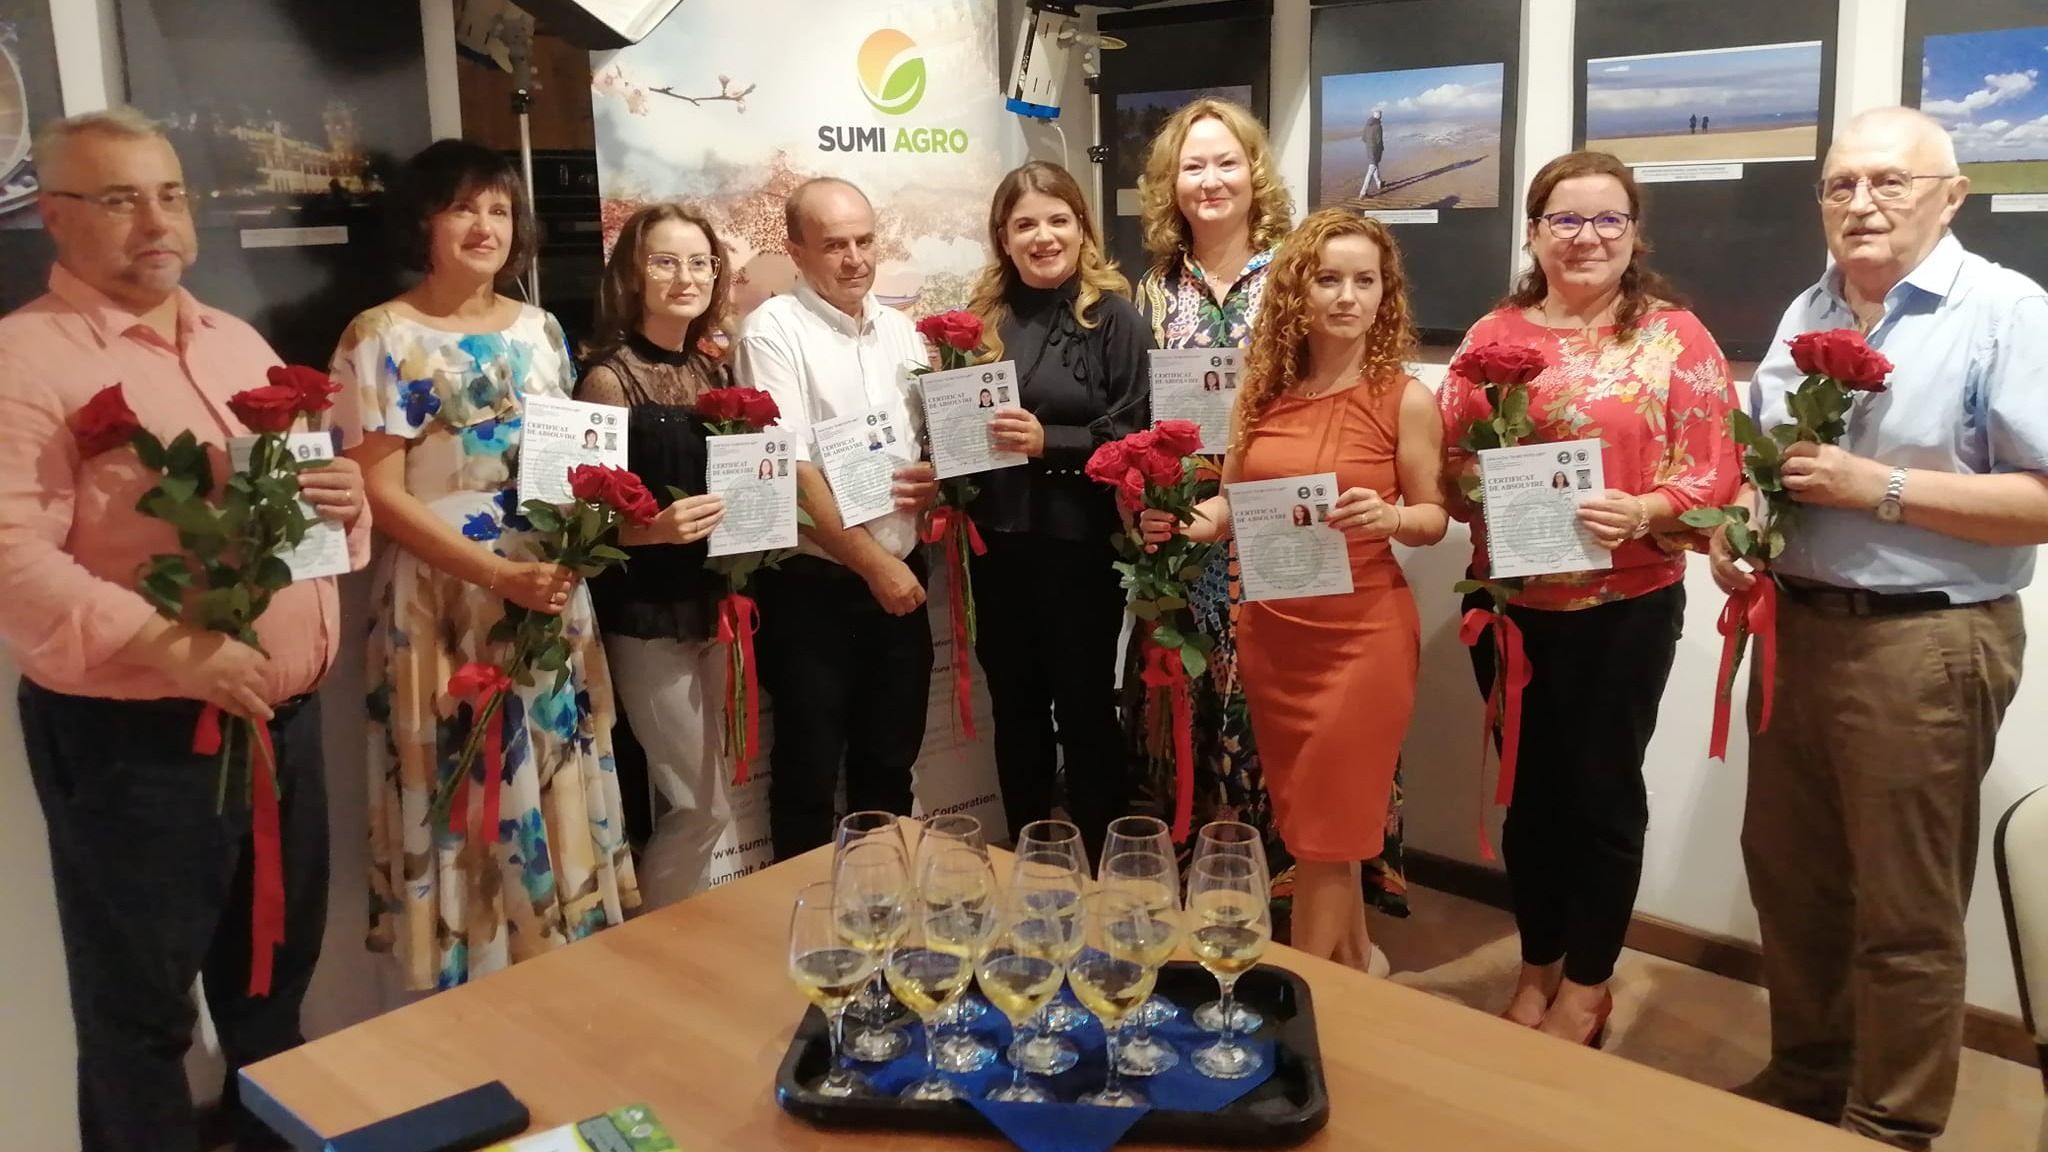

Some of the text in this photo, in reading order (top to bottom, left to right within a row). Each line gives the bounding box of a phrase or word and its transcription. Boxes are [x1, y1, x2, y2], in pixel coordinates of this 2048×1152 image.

[818, 125, 969, 154] SUMI AGRO
[1488, 474, 1535, 485] CERTIFICAT
